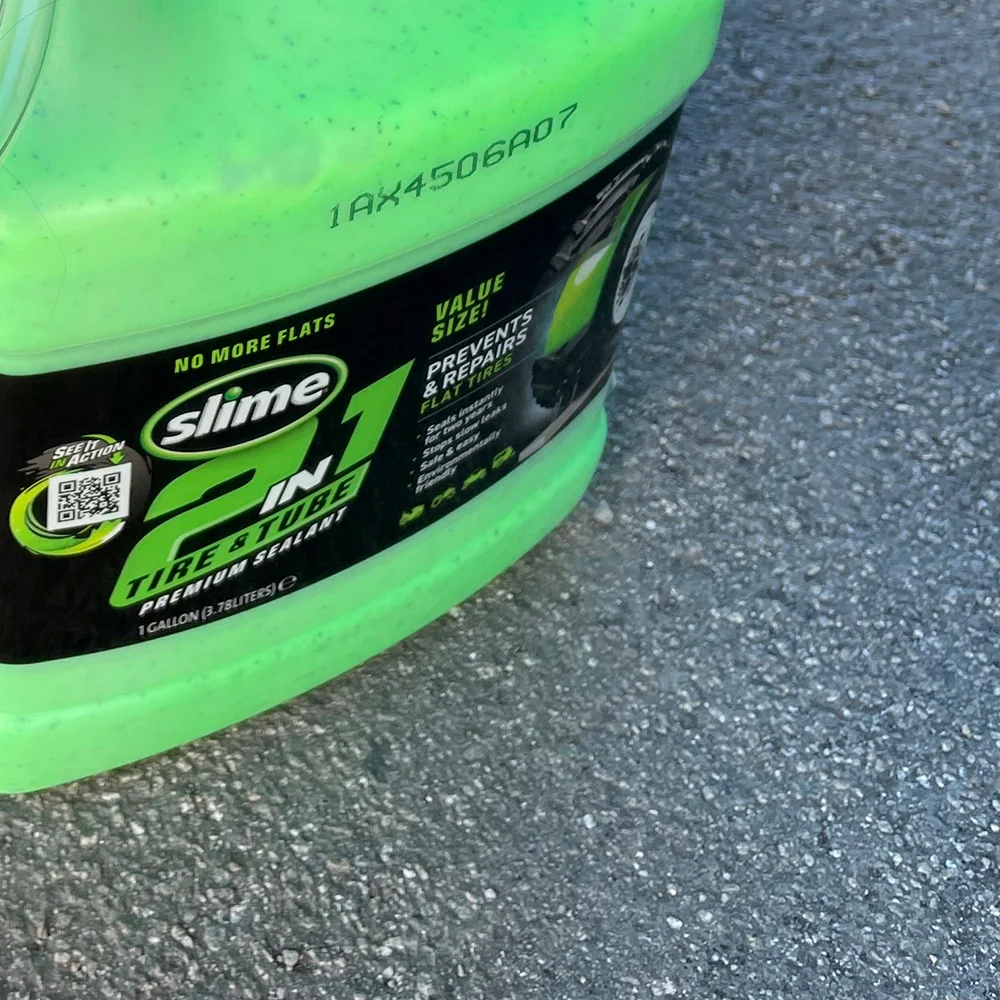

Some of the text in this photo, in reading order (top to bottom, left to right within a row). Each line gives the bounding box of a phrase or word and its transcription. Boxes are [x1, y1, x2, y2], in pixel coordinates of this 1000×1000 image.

[329, 103, 578, 229] 1AX4506A07
[431, 299, 489, 343] SIZE!
[436, 271, 505, 321] VALUE
[174, 313, 336, 374] NO MORE FLATS
[423, 327, 528, 398] & REPAIRS
[426, 308, 534, 380] PREVENTS
[160, 372, 330, 446] slime
[420, 353, 513, 414] FLAT TIRES
[427, 385, 504, 435] Seals instantly
[84, 439, 101, 452] IT
[259, 454, 334, 515] IN
[334, 358, 416, 475] 1
[420, 454, 444, 472] Safe
[456, 431, 480, 451] easy
[422, 402, 508, 458] Stops slow leaks
[425, 401, 493, 445] for two years
[65, 440, 126, 467] ACTION
[126, 474, 353, 599] TIRE & TUBE
[138, 506, 348, 616] PREMIUM SEALANT
[147, 608, 200, 634] GALLON
